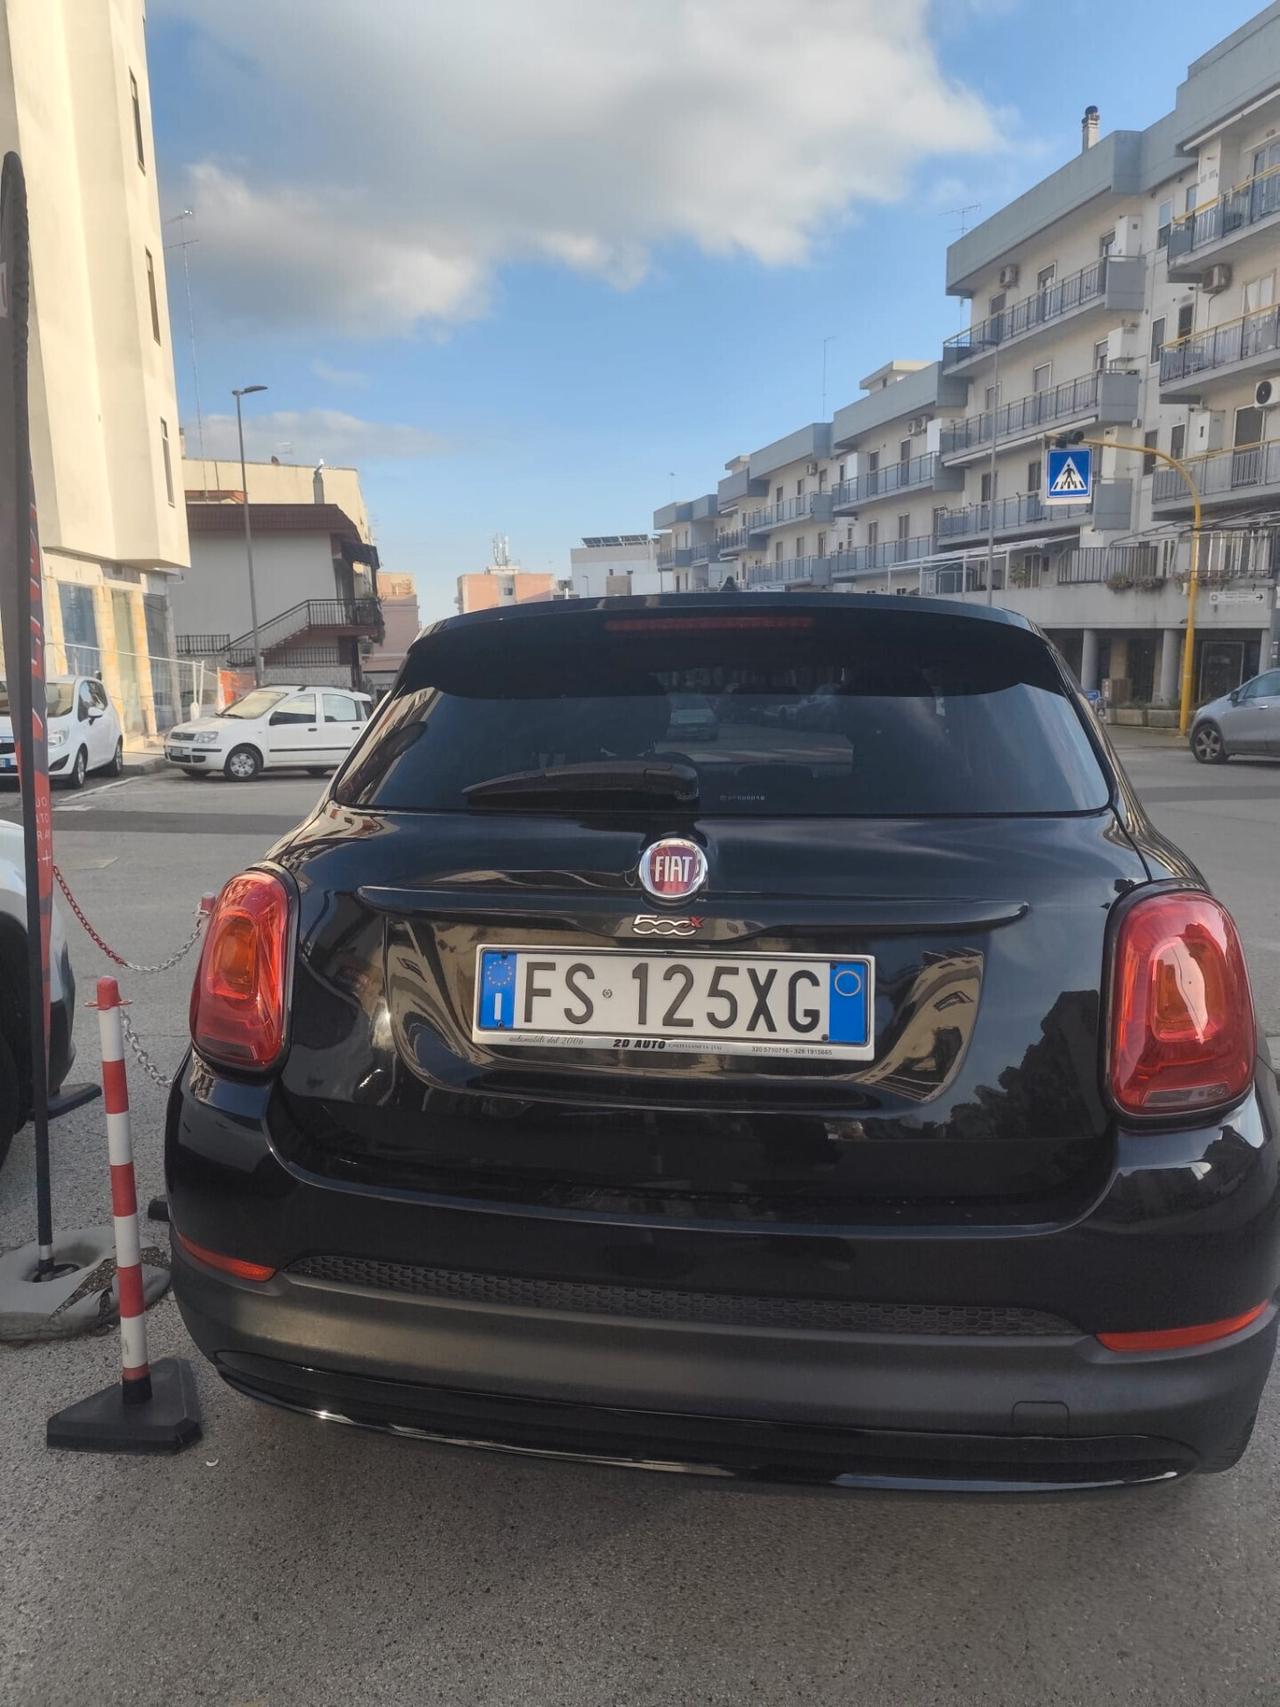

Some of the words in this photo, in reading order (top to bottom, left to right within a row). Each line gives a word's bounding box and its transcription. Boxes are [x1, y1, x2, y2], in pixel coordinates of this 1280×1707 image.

[654, 855, 693, 883] FIAT
[493, 991, 503, 1021] I
[523, 960, 596, 1025] FS
[631, 961, 821, 1035] 125XG
[612, 1038, 630, 1048] 2D
[634, 1039, 666, 1050] AUTO
